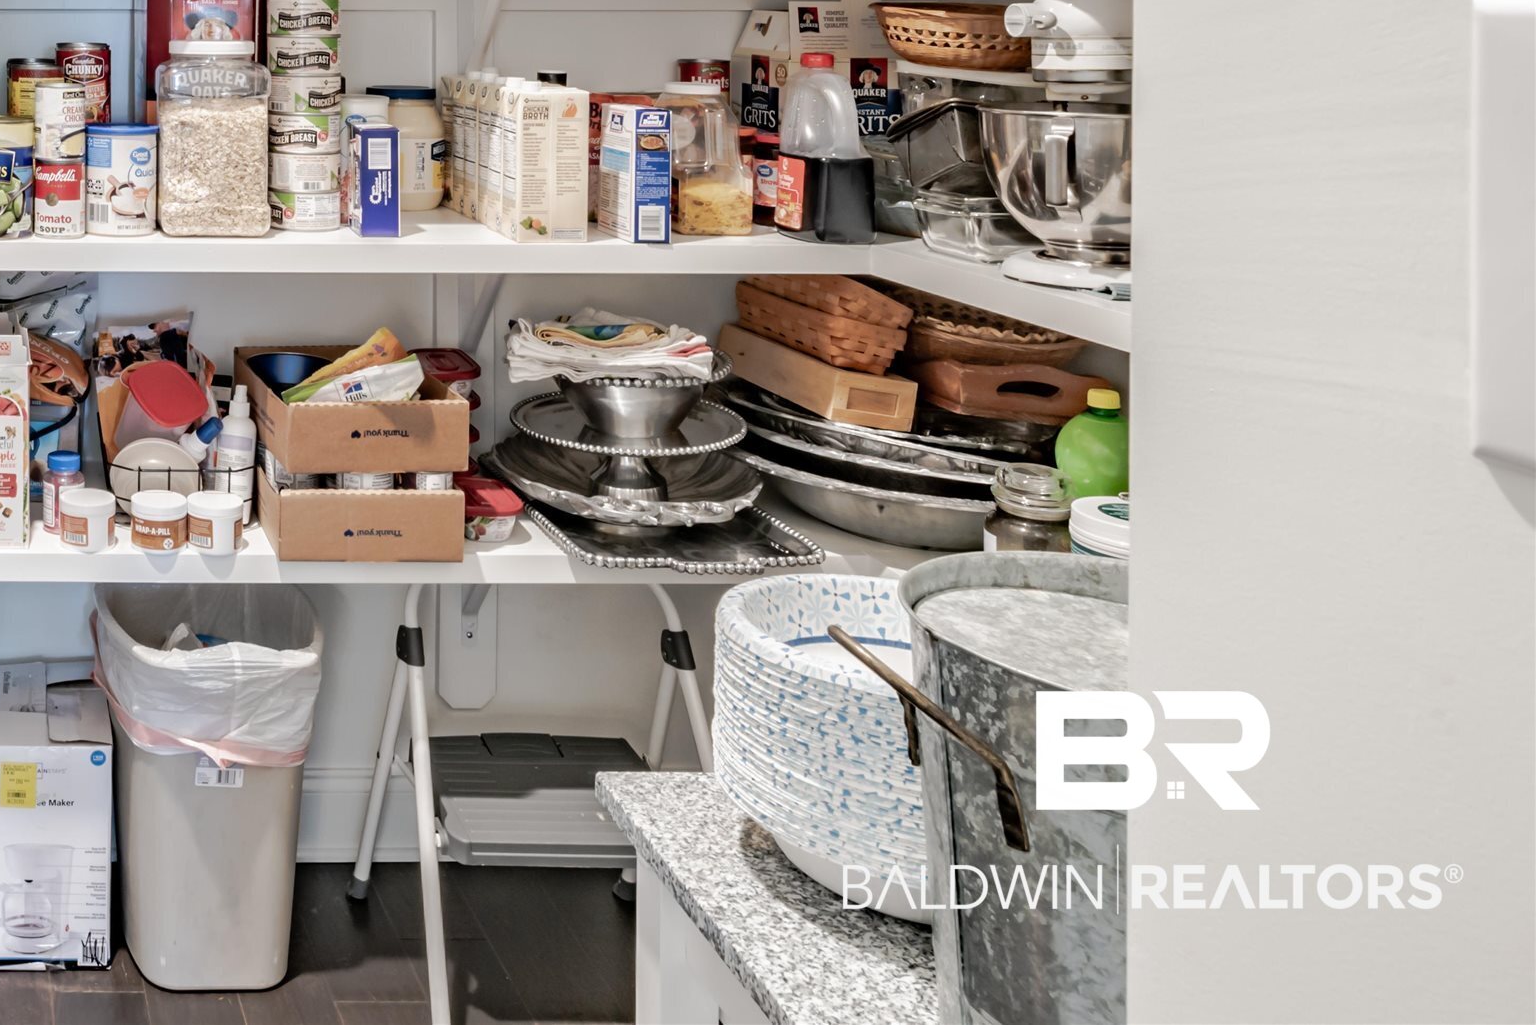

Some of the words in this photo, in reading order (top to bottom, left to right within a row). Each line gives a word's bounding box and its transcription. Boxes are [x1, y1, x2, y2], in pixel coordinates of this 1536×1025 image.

[279, 18, 307, 28] CHICKEN
[308, 16, 331, 26] BREAST
[278, 57, 304, 67] CHICKEN
[305, 55, 329, 65] BREAST
[65, 63, 103, 76] CHUNKY
[178, 69, 247, 88] QUAKER
[751, 85, 769, 94] QUAKER
[853, 89, 886, 98] QUAKER
[310, 96, 334, 107] CHICKEN
[743, 108, 776, 127] GRITS
[858, 114, 901, 134] RITS
[291, 133, 316, 143] BREAST
[35, 166, 77, 184] Campbell's
[37, 213, 72, 223] Tomato
[39, 225, 66, 233] SOUP
[345, 392, 368, 402] Hill's
[364, 430, 382, 438] you!
[383, 430, 409, 438] Thank
[135, 524, 171, 536] WRAP-A-PILL
[356, 529, 375, 537] you!
[376, 529, 403, 537] Thank
